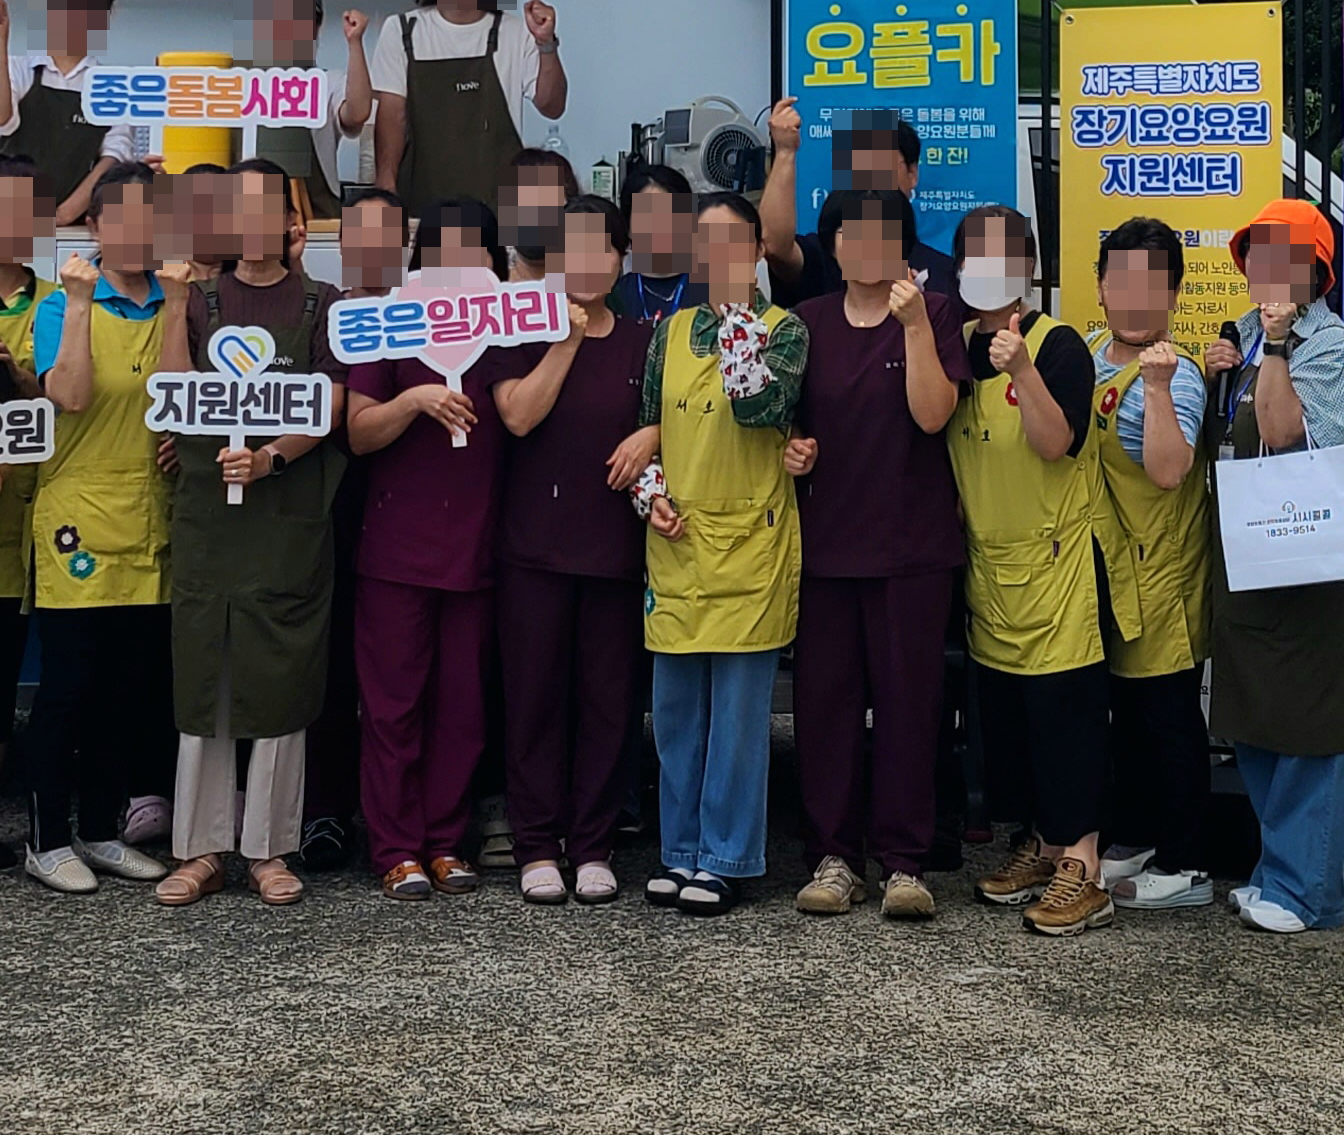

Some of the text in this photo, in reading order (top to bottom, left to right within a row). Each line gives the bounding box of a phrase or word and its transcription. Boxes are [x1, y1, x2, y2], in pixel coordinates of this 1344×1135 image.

[802, 19, 1002, 90] 요플카
[1081, 61, 1262, 96] 제주특별자치도
[916, 107, 957, 123] 돌봄을
[958, 107, 986, 123] 위해
[1070, 101, 1274, 150] 장기요양요원
[926, 147, 969, 165] 한 잔!
[1099, 153, 1243, 199] 지원센터
[919, 190, 976, 201] 제주특별자치도
[1195, 302, 1228, 316] 자로서
[154, 380, 322, 428] 지원센터
[1265, 524, 1316, 539] 1833-9514
